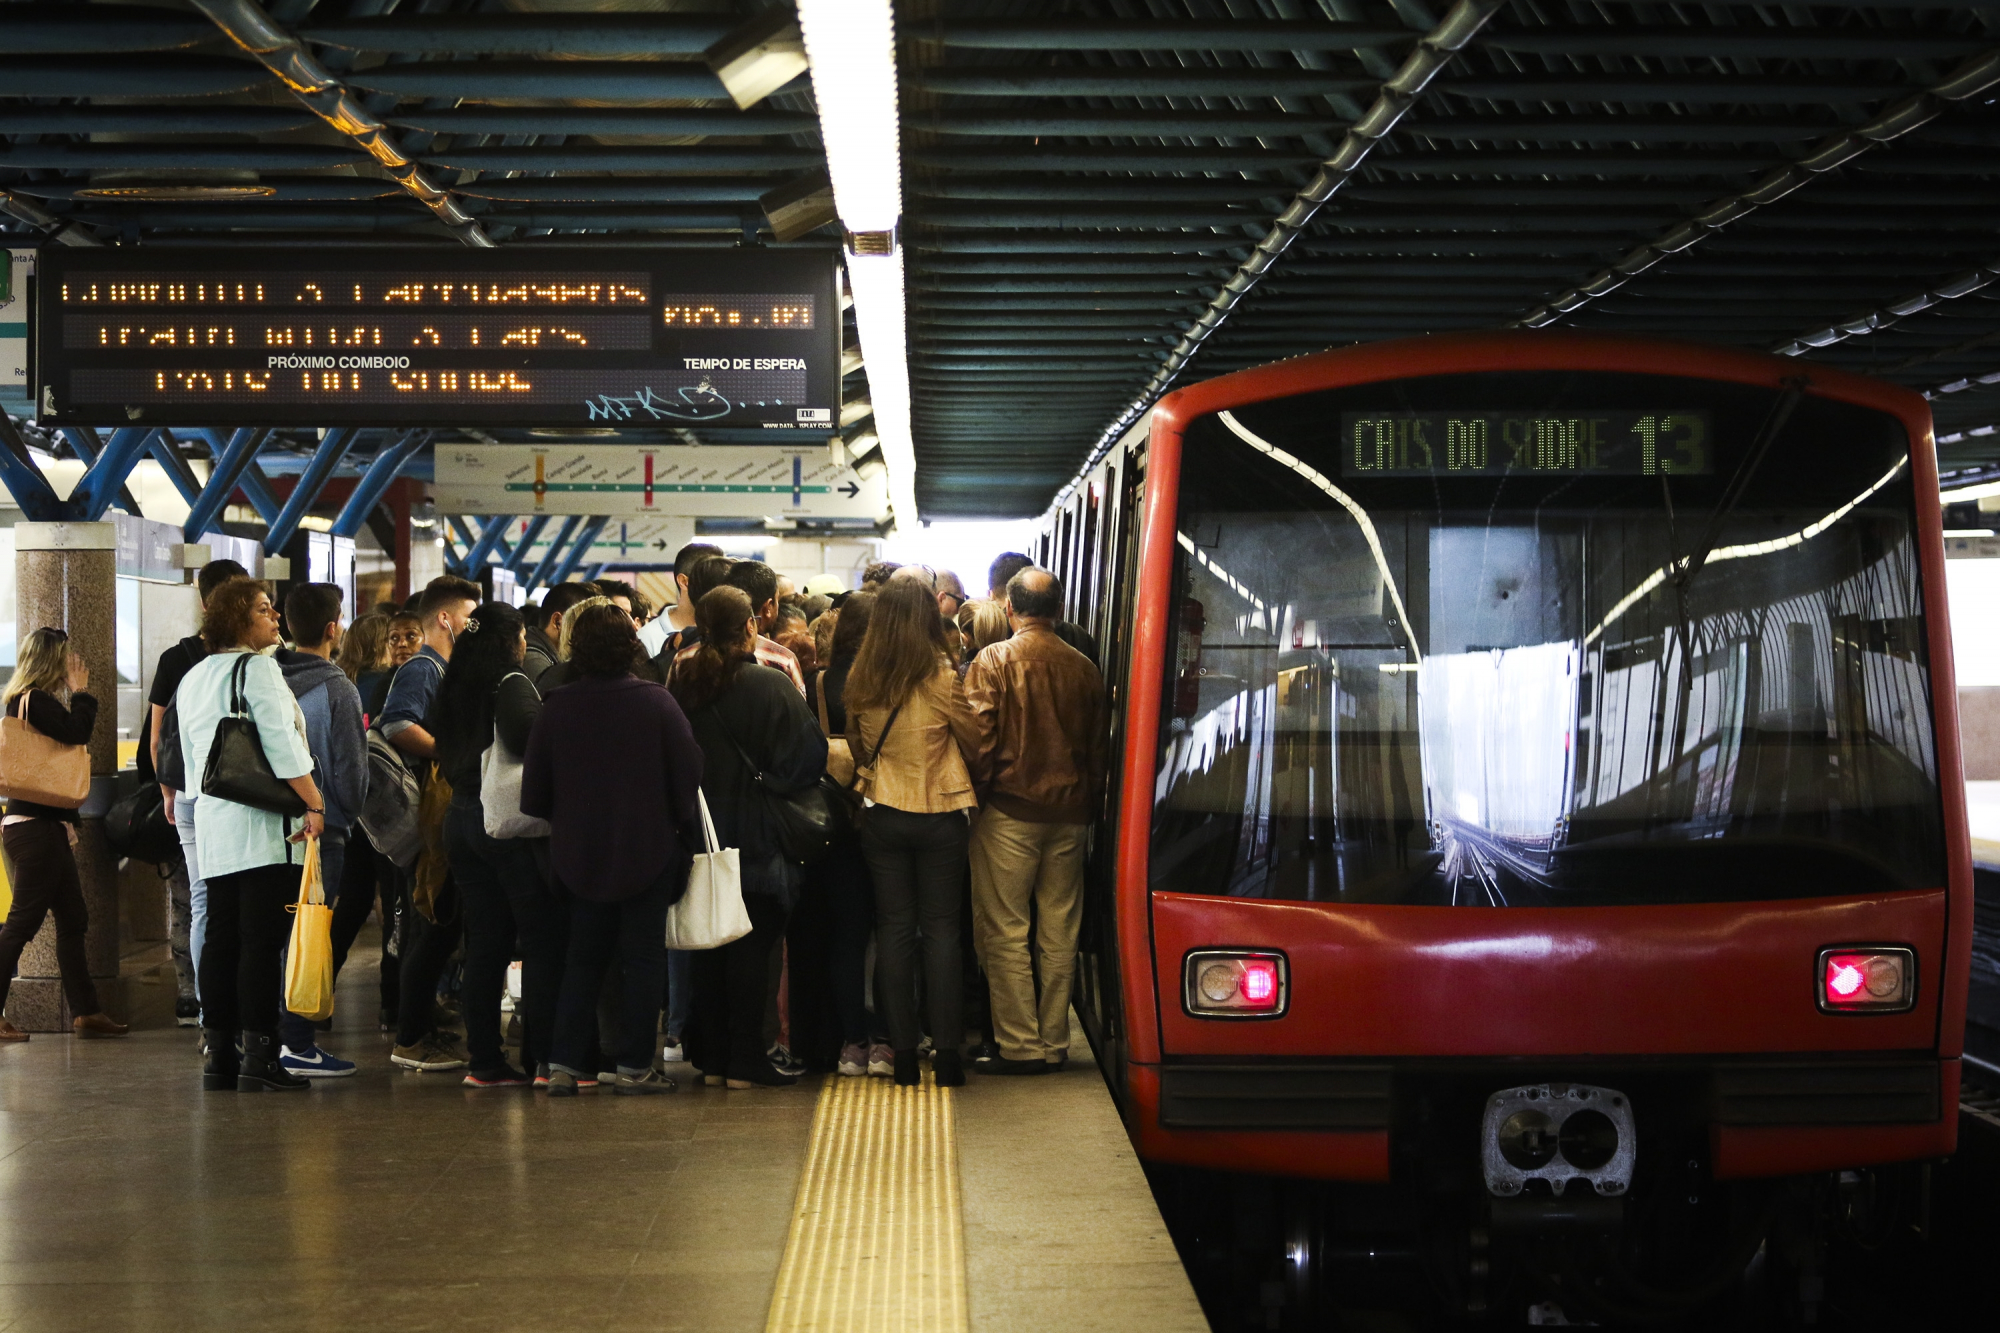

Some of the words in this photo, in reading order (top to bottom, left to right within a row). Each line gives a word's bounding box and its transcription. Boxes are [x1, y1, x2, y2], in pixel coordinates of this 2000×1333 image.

[267, 353, 335, 370] PRÓXIMO
[338, 355, 411, 370] COMBOIO
[683, 357, 731, 370] TEMPO
[732, 357, 752, 370] DE
[753, 357, 807, 370] ESPERA
[1354, 418, 1434, 471] CAIS
[1447, 418, 1488, 471] DO
[1502, 418, 1610, 471] SODRE
[1630, 415, 1705, 476] 13
